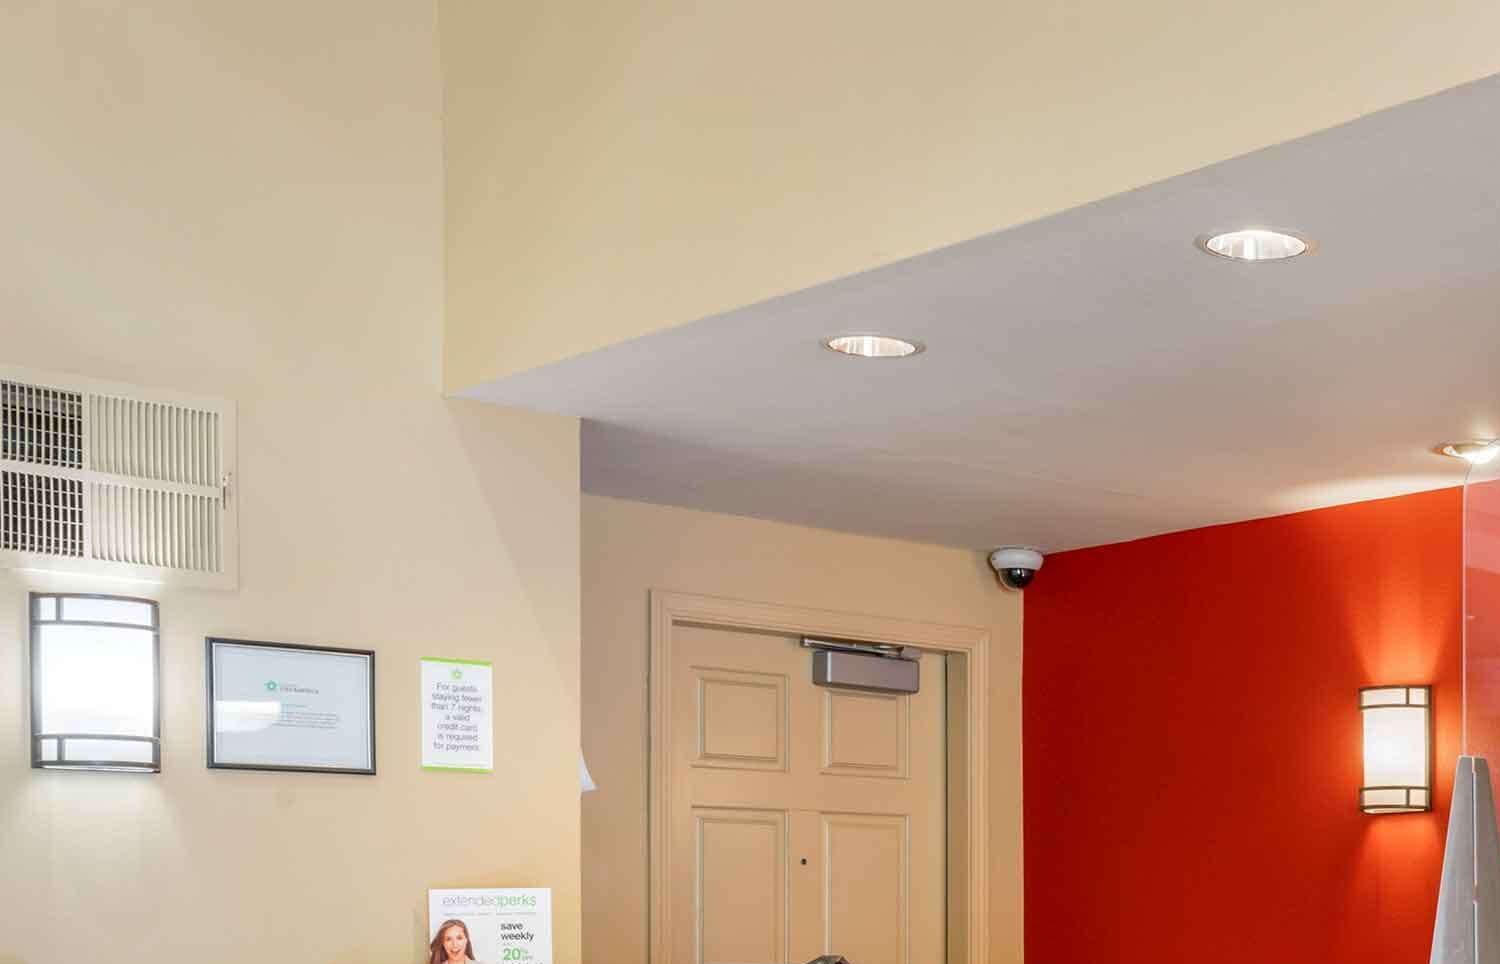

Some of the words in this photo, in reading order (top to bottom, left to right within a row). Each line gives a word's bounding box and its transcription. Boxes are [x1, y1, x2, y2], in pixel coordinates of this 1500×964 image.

[436, 682, 450, 690] For
[432, 693, 460, 702] staying
[460, 724, 478, 732] card
[445, 734, 479, 742] required
[500, 922, 524, 931] save
[500, 932, 534, 943] weekly
